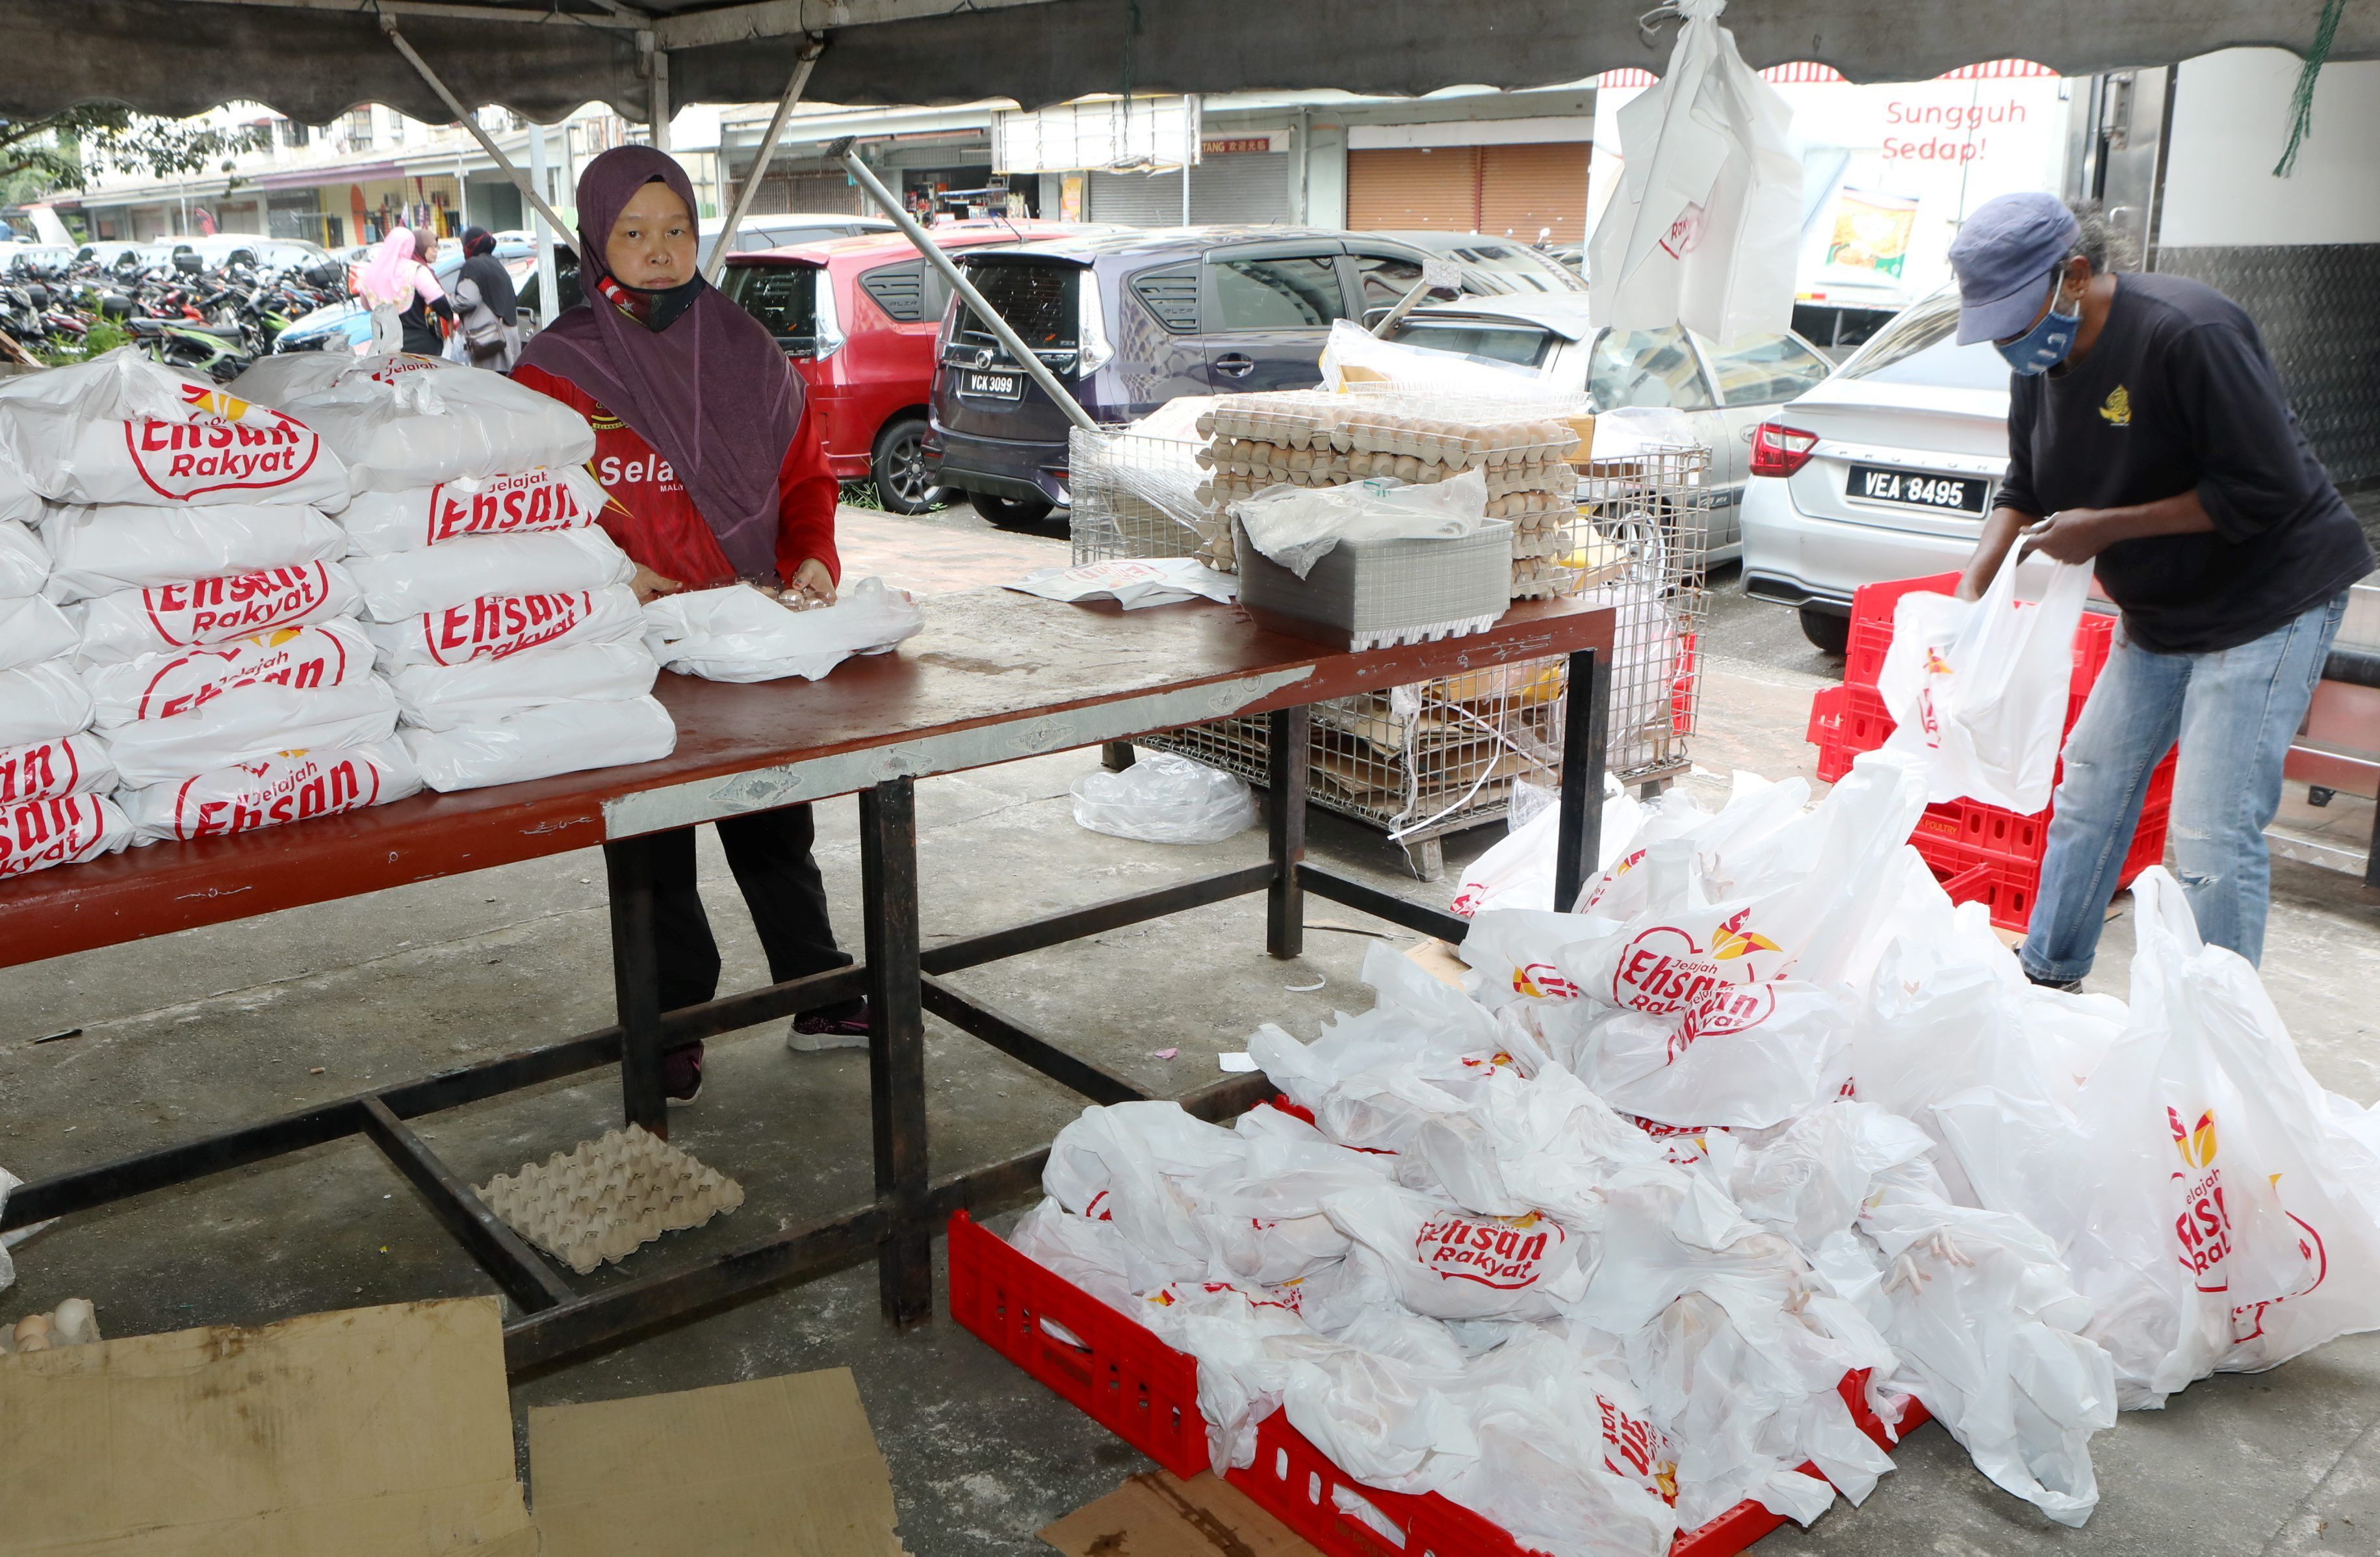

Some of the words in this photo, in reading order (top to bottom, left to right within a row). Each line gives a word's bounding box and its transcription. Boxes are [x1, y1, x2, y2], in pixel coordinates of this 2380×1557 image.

[1886, 99, 2026, 130] Sungguh
[1882, 136, 1986, 166] Sedap!
[971, 374, 989, 391] VCK
[989, 376, 1013, 393] 3099
[168, 447, 295, 480] Rakyat
[599, 454, 674, 486] Sela
[1865, 471, 1901, 499] VEA
[1908, 477, 1965, 507] 8495
[436, 483, 579, 540] Ehsan
[192, 582, 315, 636] Rakyat
[440, 593, 575, 650] Ehsan
[192, 760, 360, 840] Ehsan
[252, 761, 318, 806] Jelajah
[1924, 819, 1958, 836] POULTRY
[1622, 949, 1737, 1002] Ehsa
[2186, 1168, 2221, 1205] elajah
[1432, 1246, 1533, 1279] Rakyat
